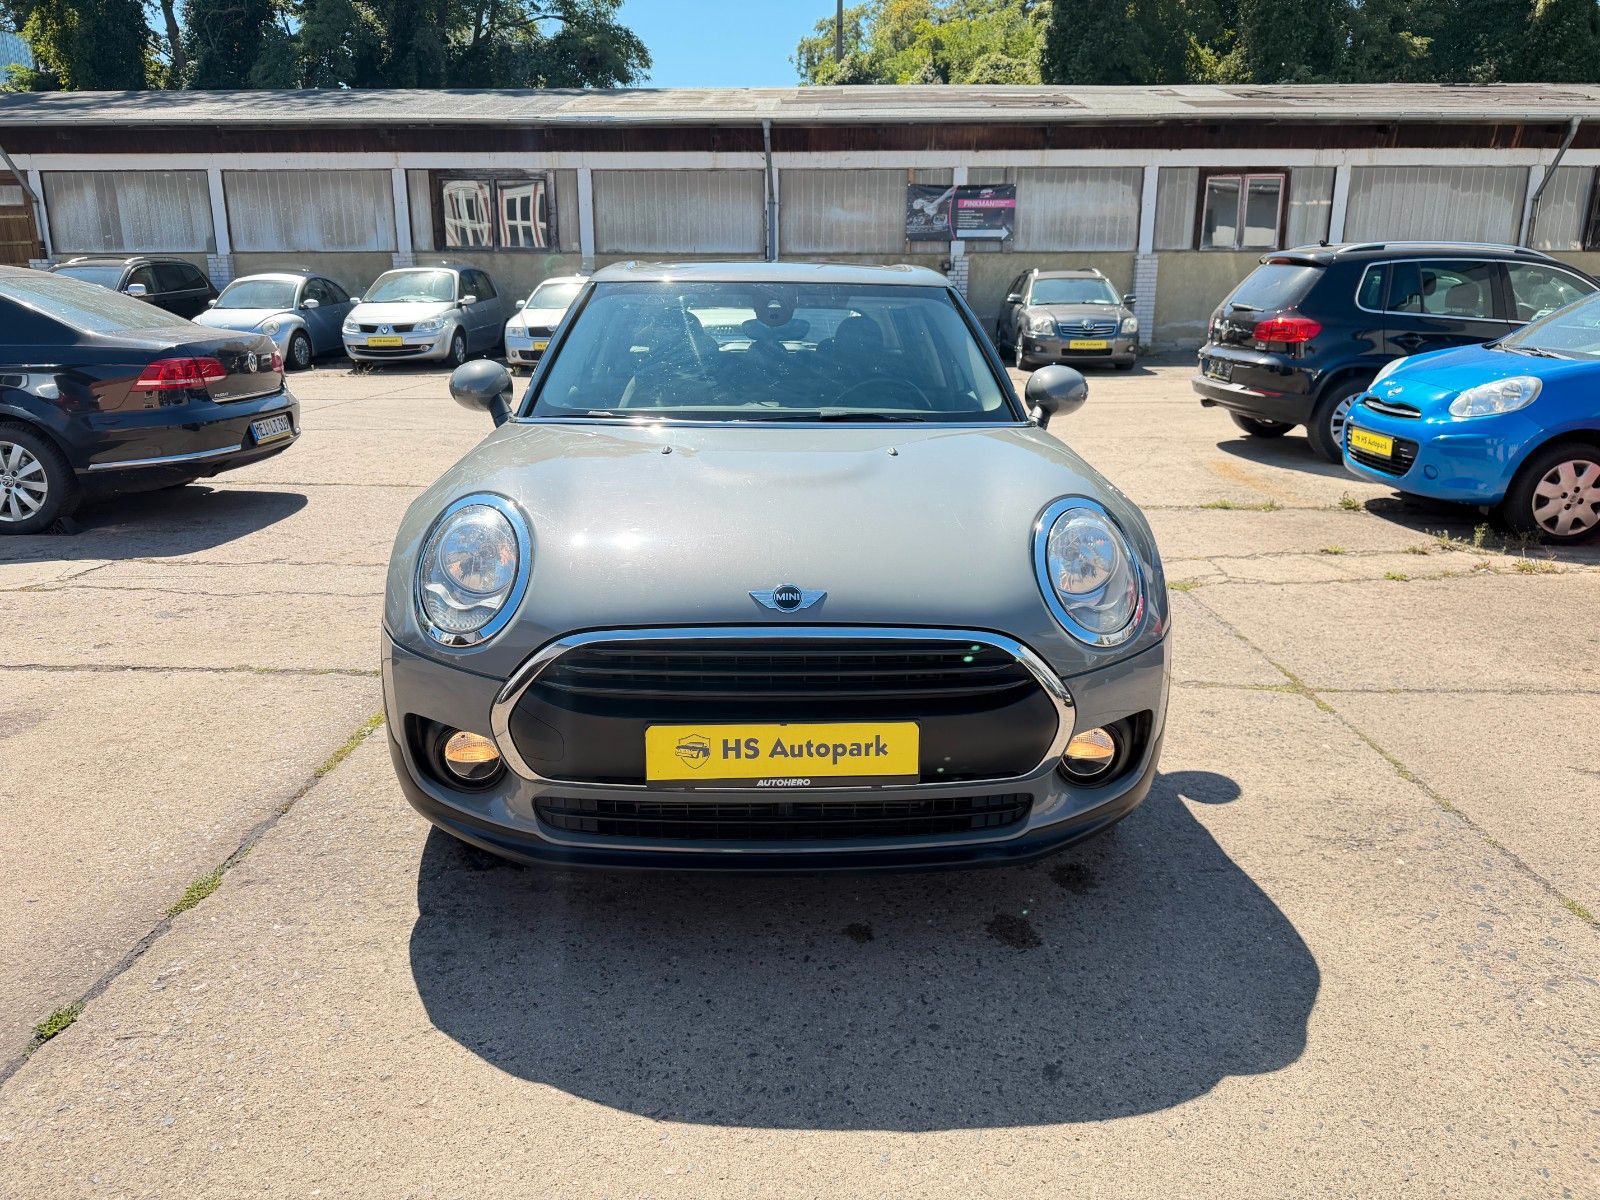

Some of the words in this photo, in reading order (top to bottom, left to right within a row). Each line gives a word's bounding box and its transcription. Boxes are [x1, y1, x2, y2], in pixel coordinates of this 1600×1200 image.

[775, 592, 800, 601] MINI
[722, 738, 760, 760] HS
[768, 735, 889, 765] Autopark
[756, 778, 811, 787] AUTOHERO
